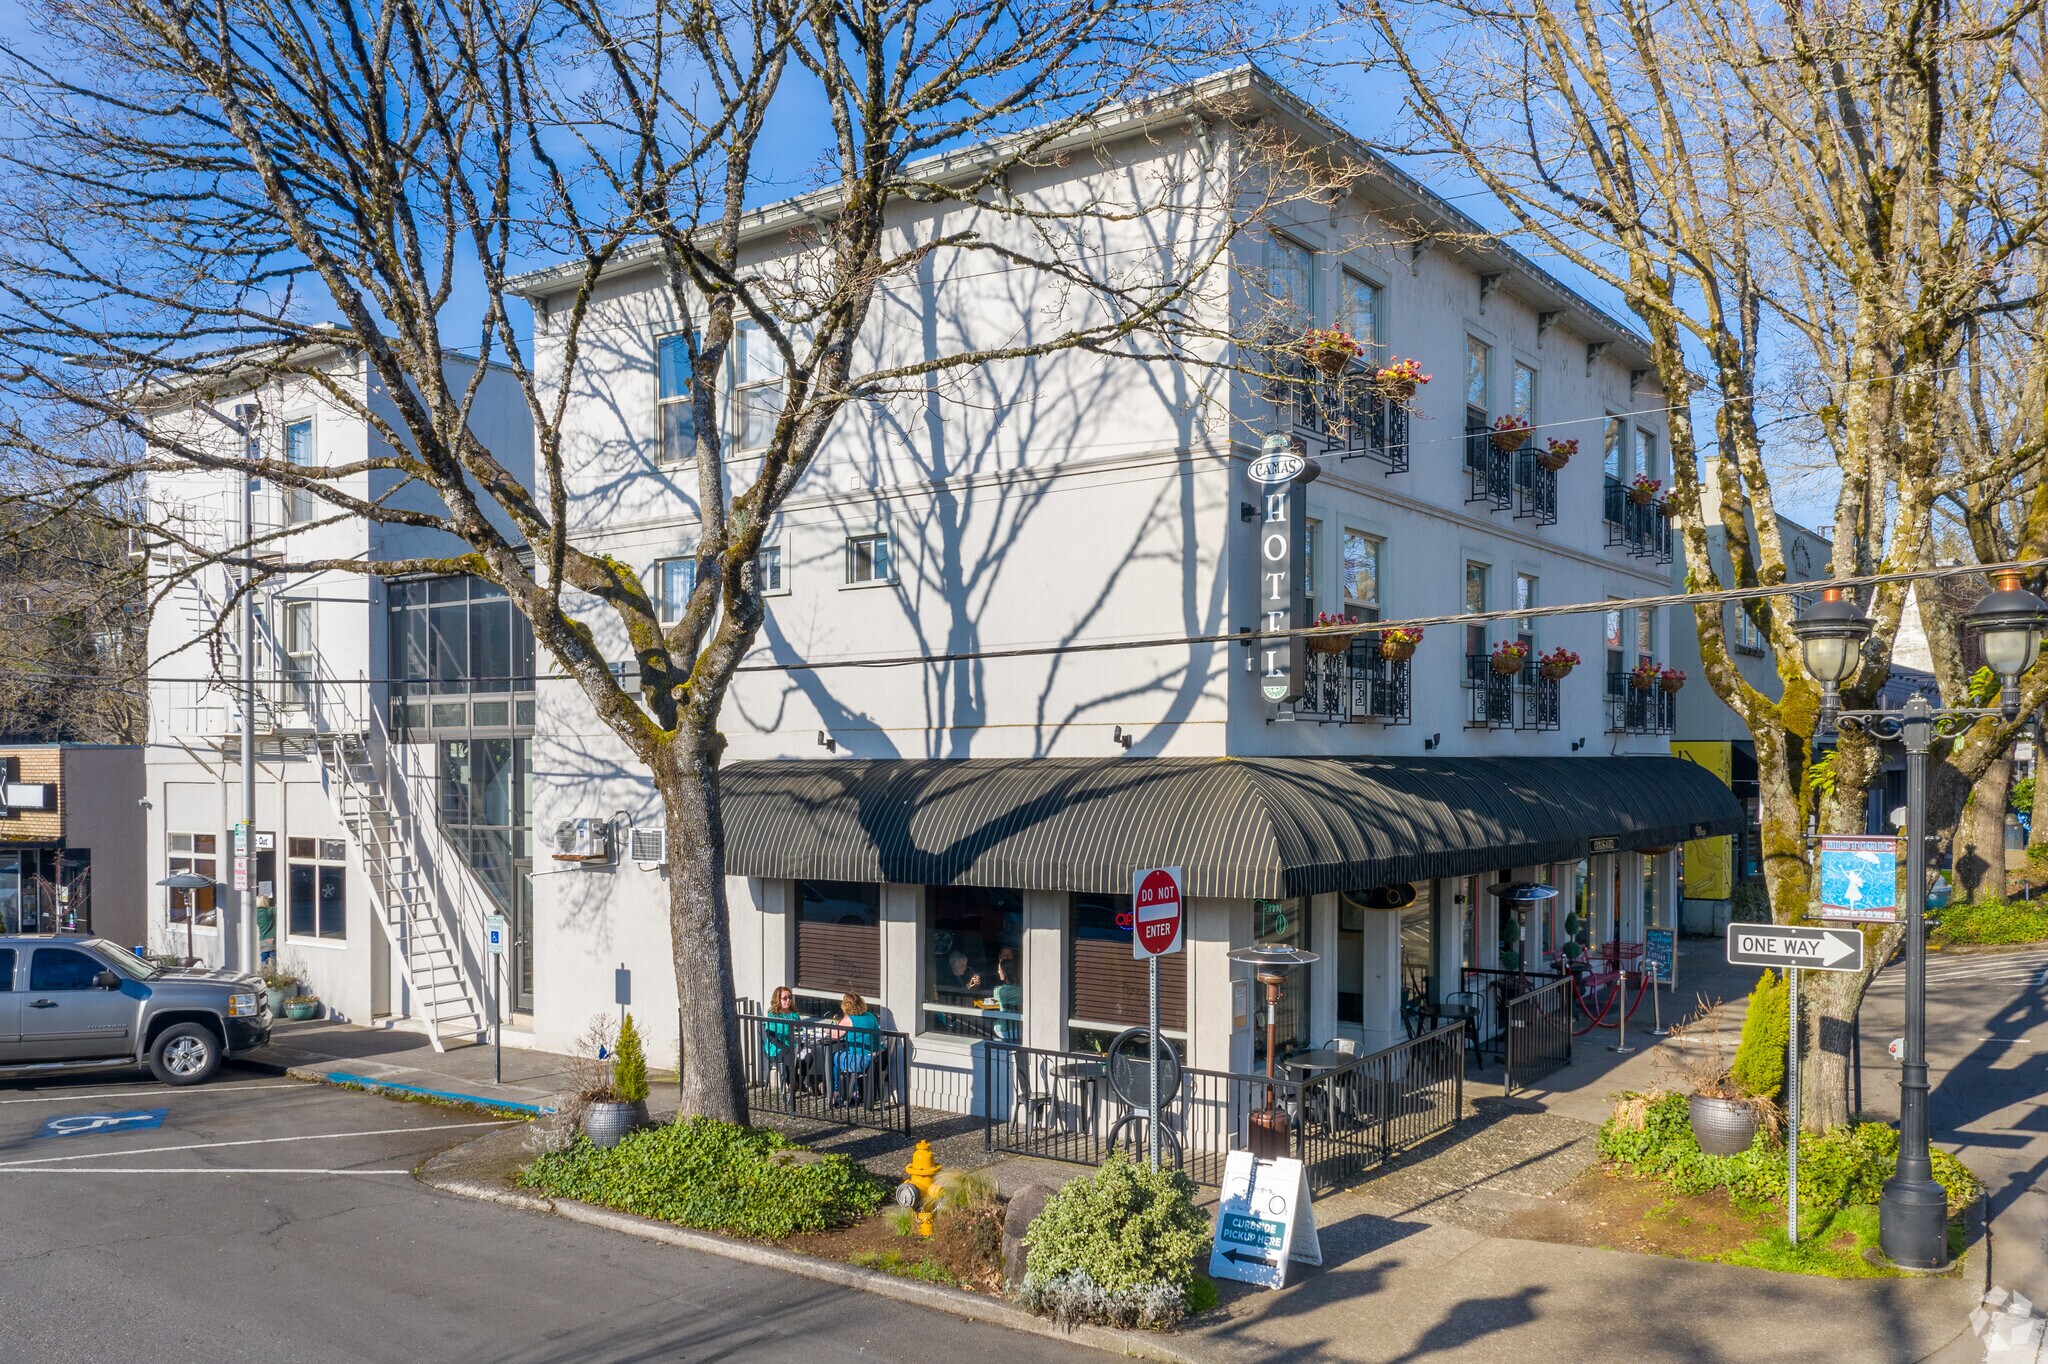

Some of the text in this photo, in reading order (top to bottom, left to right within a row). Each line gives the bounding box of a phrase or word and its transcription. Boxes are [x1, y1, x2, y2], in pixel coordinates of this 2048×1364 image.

[1255, 459, 1297, 477] CAMAS
[1263, 493, 1287, 678] HOTEL
[1825, 840, 1892, 851] HISTORIC
[1141, 886, 1175, 902] DO NOT
[1115, 913, 1134, 926] OP
[1826, 908, 1891, 919] DOWNTOWN
[1145, 923, 1171, 939] ENTER
[1743, 937, 1820, 956] ONE WAY
[1232, 1218, 1277, 1234] CURBSIDE
[1223, 1229, 1282, 1248] PICKUP HERE
